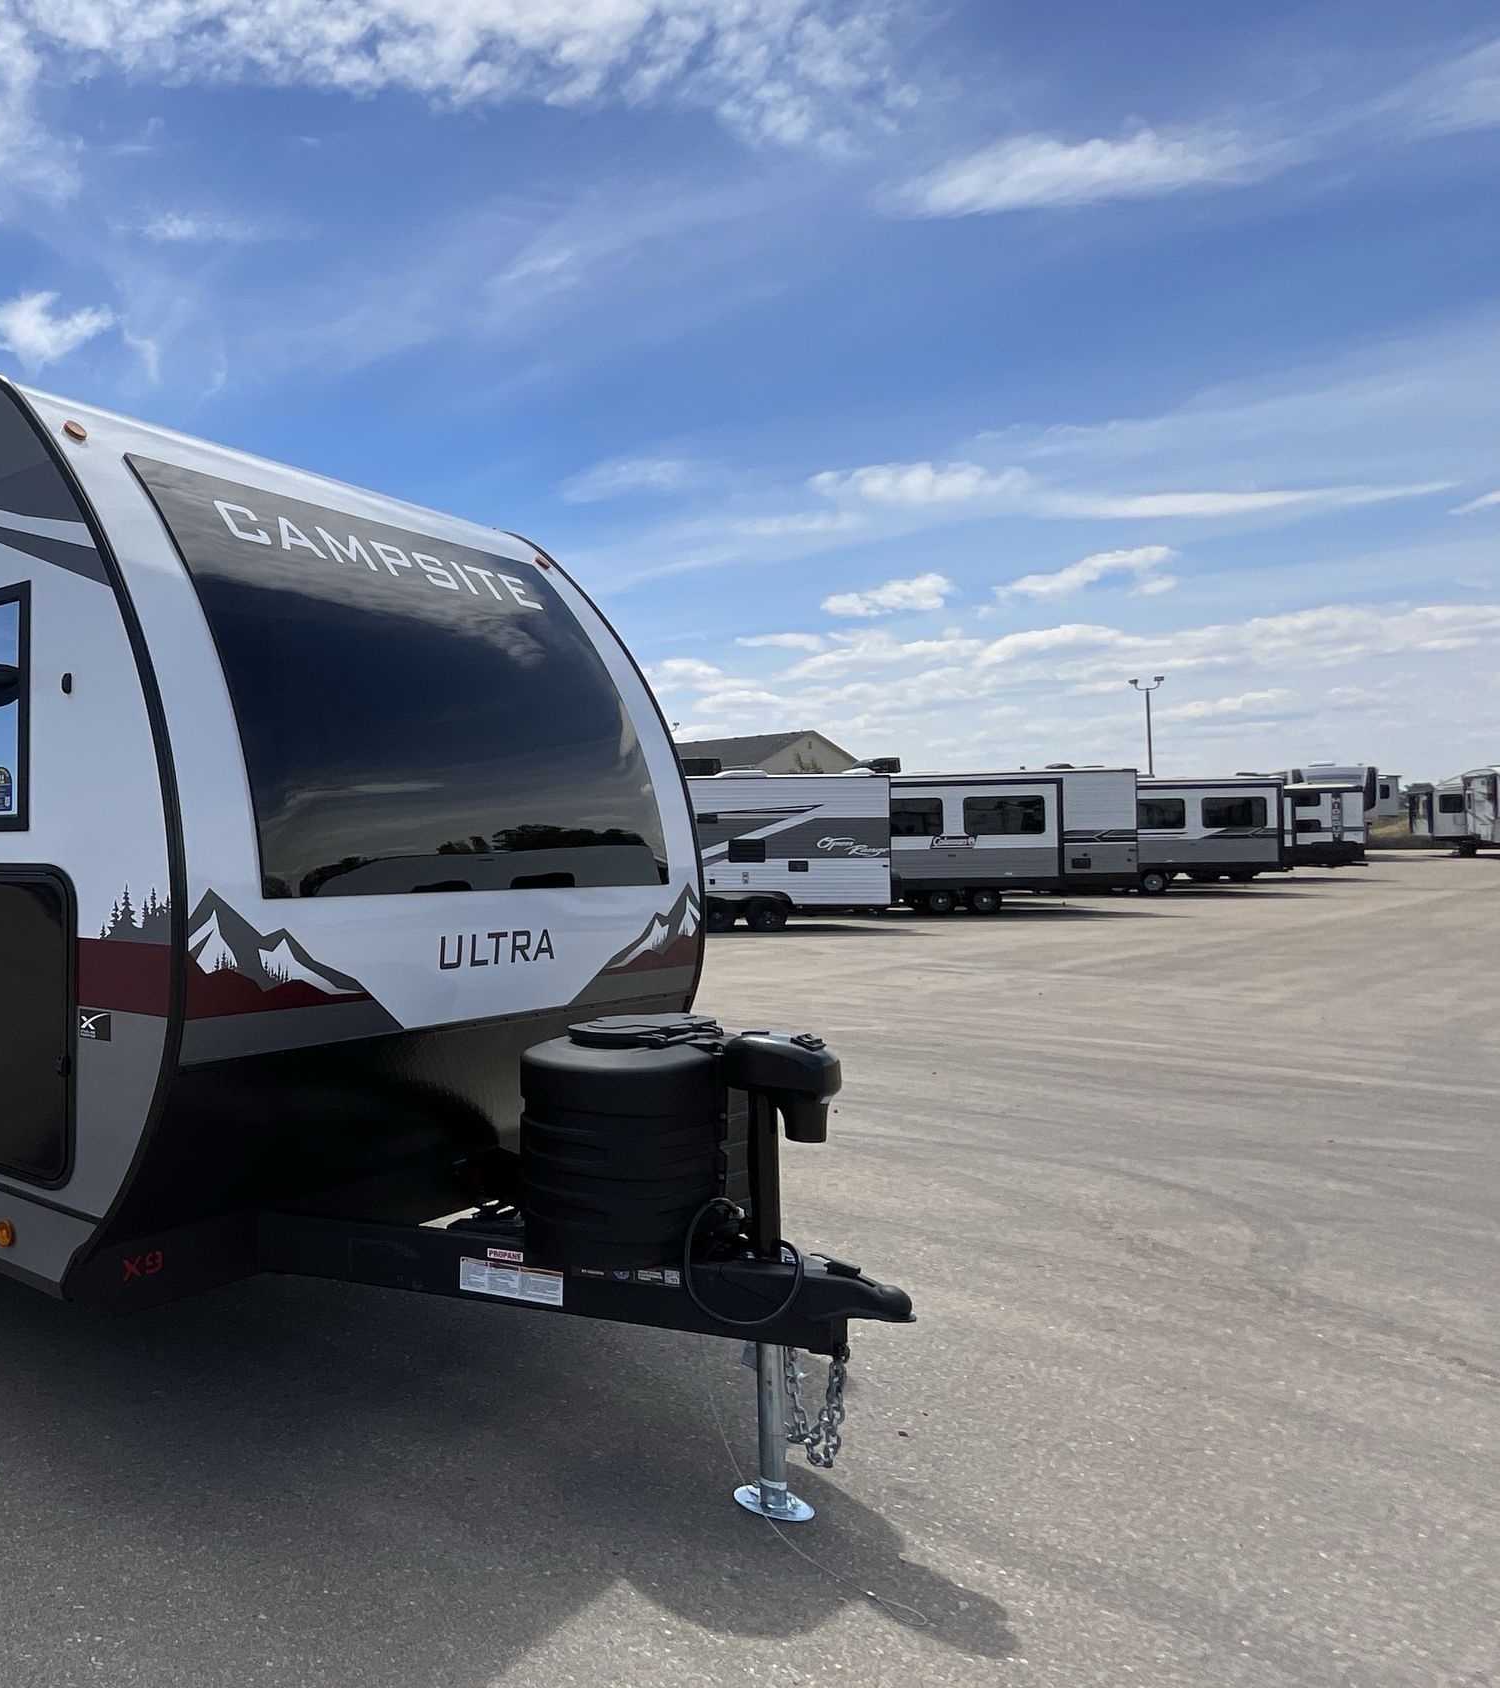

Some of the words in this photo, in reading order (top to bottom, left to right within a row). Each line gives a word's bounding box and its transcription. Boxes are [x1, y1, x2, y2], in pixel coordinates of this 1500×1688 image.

[213, 500, 543, 610] CAMPSITE
[816, 837, 855, 851] Open
[932, 837, 967, 846] Coleman
[440, 929, 555, 970] ULTRA
[488, 1249, 522, 1261] PROPANE
